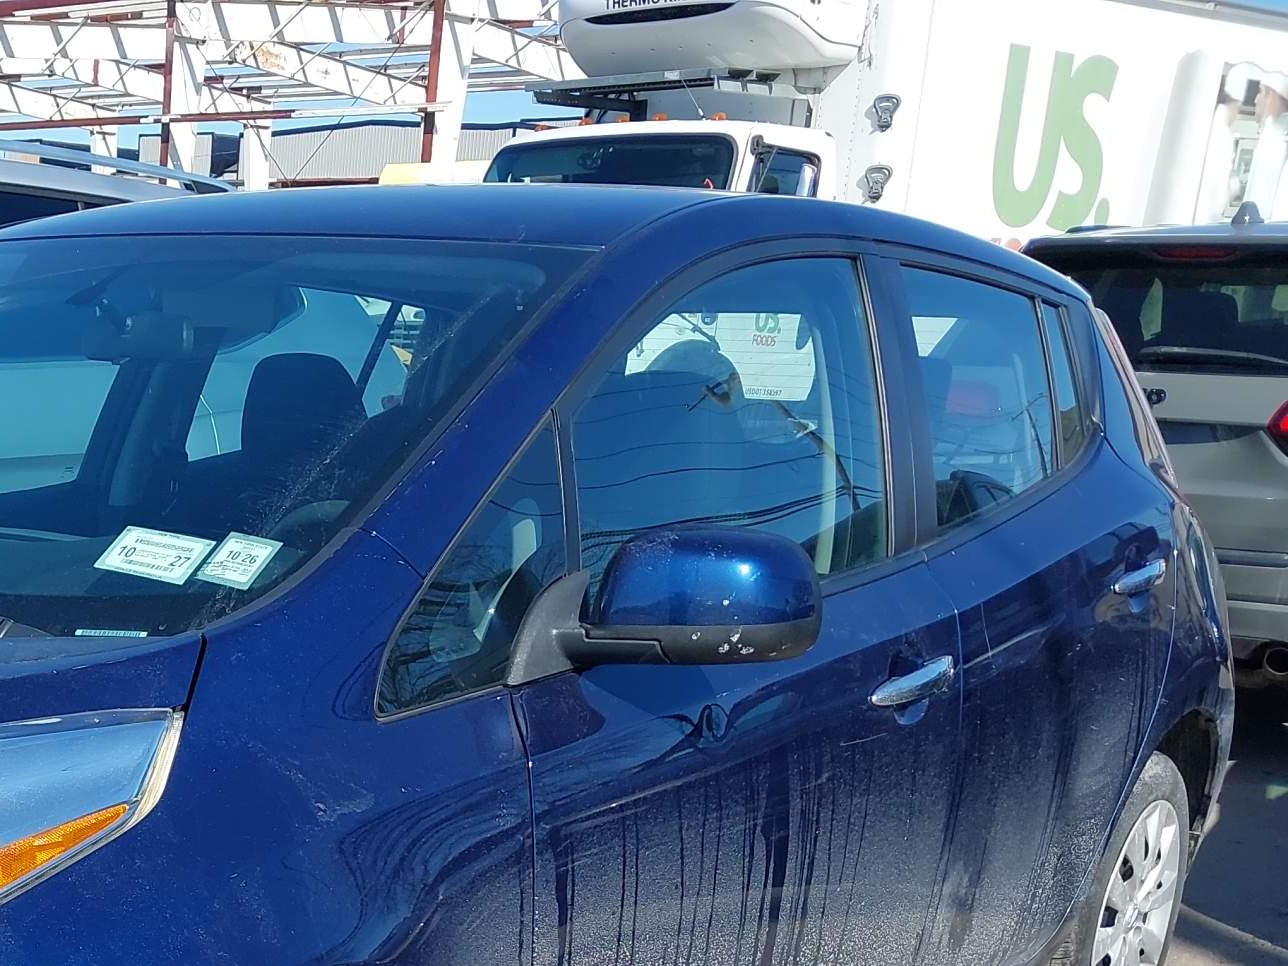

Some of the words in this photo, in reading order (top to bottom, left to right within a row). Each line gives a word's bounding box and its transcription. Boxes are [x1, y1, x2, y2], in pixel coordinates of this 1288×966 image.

[992, 43, 1119, 231] US.
[752, 334, 777, 347] FOODS
[118, 545, 137, 558] 10
[168, 555, 191, 568] 27
